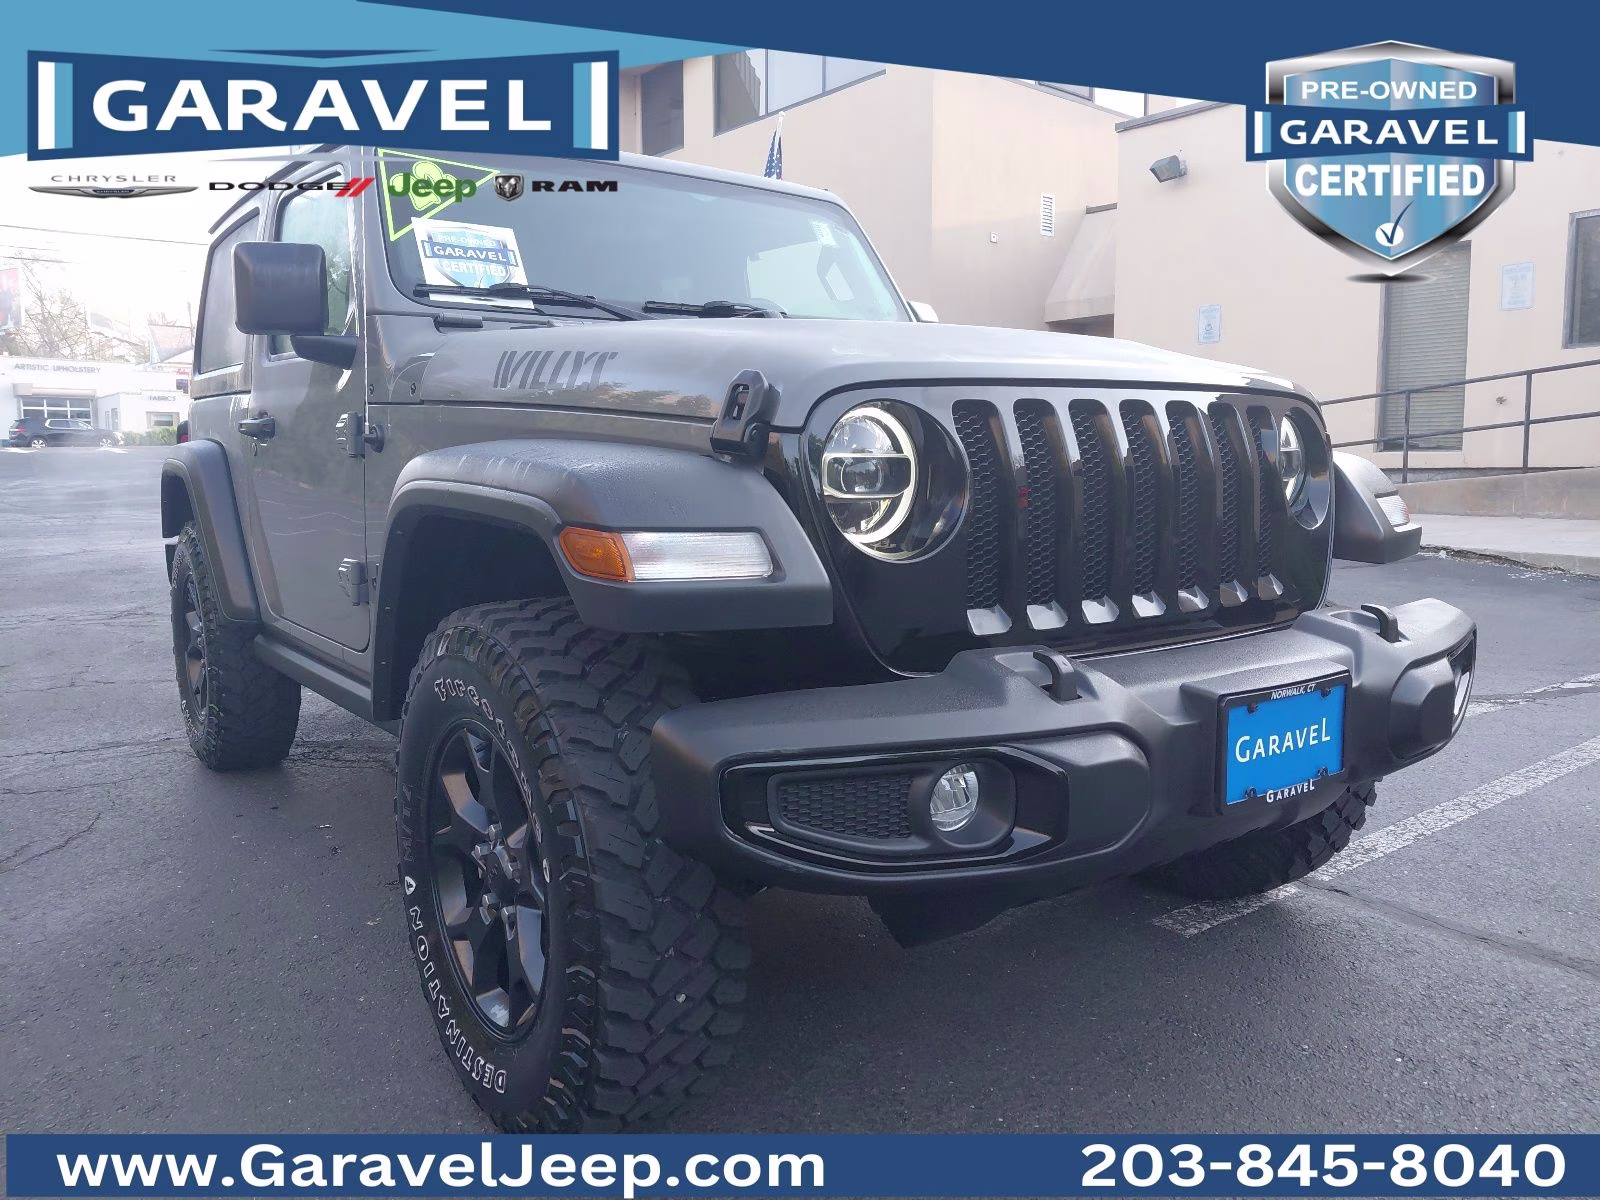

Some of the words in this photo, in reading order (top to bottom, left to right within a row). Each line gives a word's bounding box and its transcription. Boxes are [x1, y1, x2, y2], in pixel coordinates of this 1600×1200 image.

[433, 246, 508, 262] GARAVEL
[441, 261, 507, 277] CERTIFIED
[14, 363, 49, 372] ARTISTIC
[53, 365, 101, 374] UPHOLSTERY
[1307, 684, 1317, 692] CT
[1235, 717, 1331, 763] GARAVEL
[1266, 778, 1315, 803] GARAVEL
[409, 906, 507, 1094] DESTINATION
